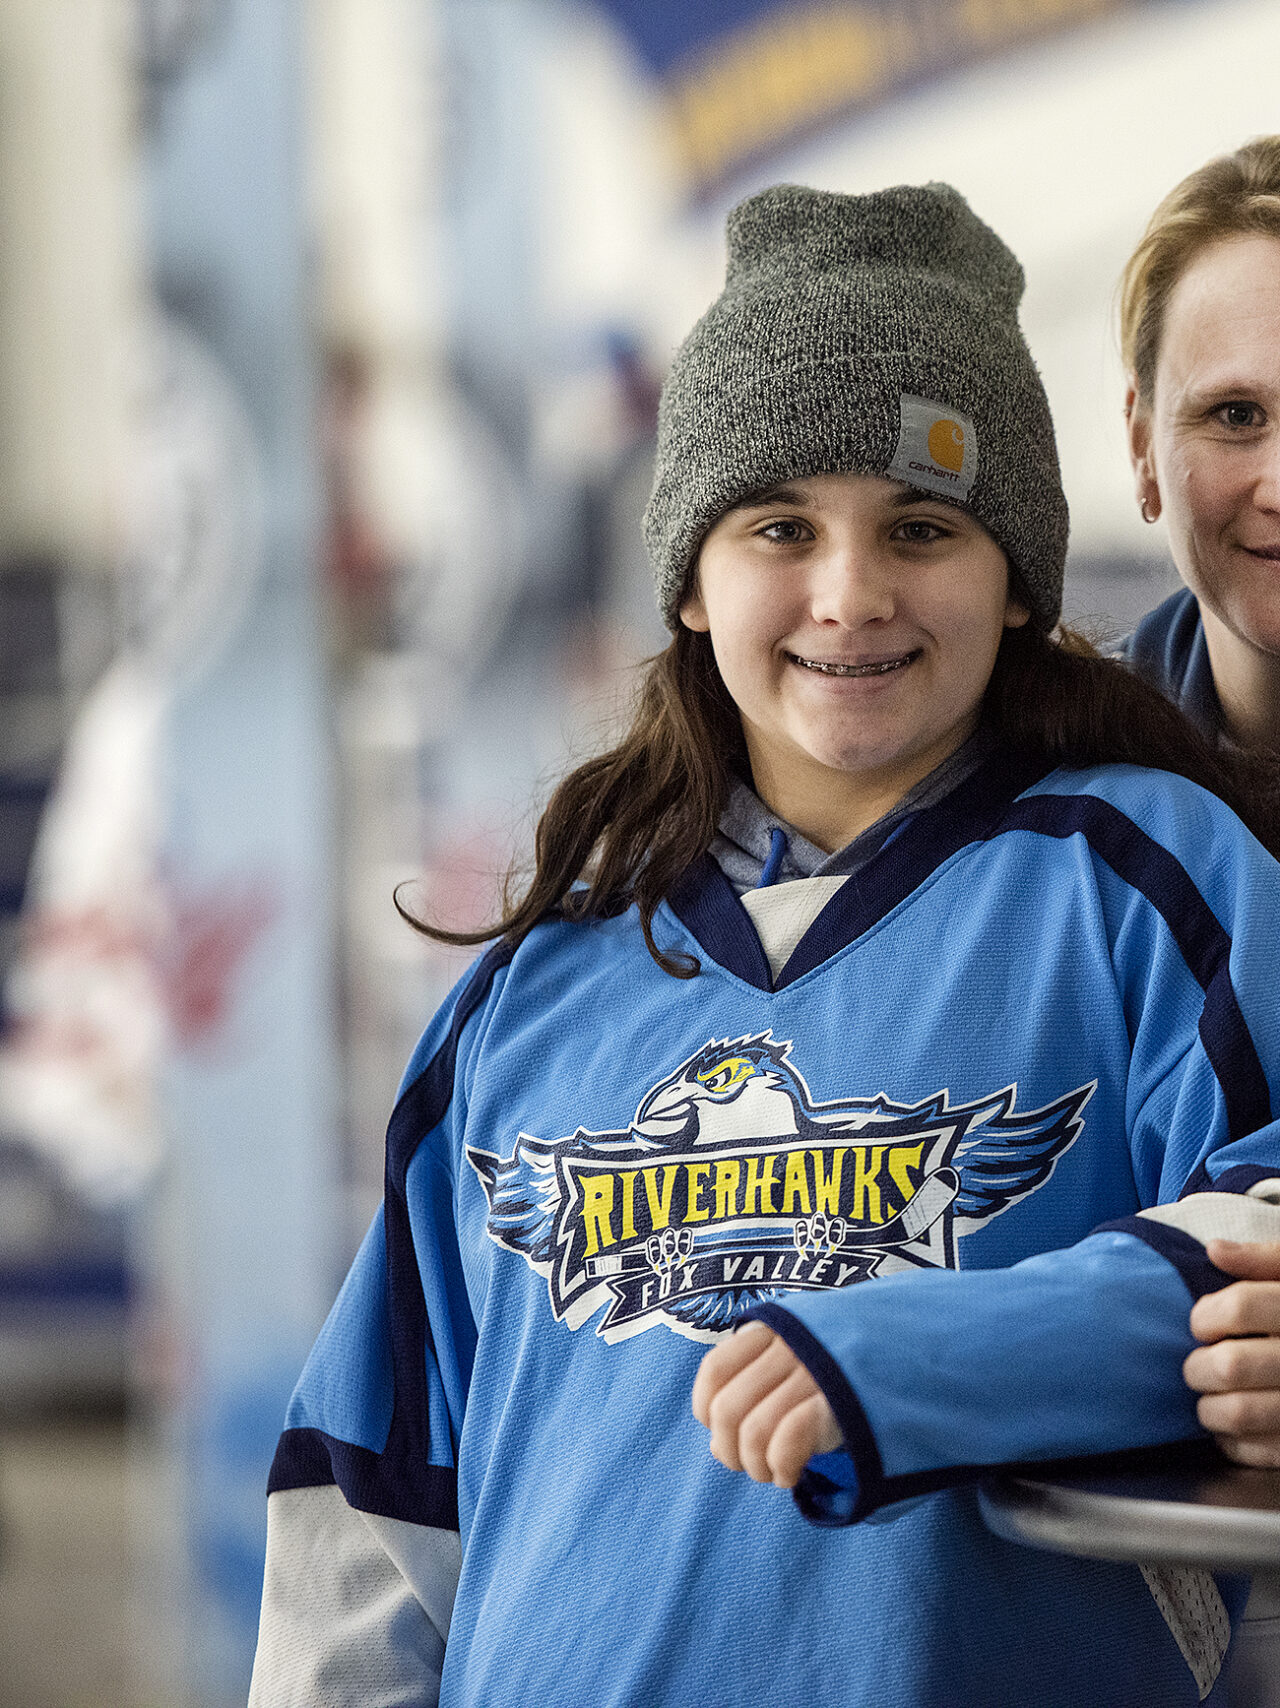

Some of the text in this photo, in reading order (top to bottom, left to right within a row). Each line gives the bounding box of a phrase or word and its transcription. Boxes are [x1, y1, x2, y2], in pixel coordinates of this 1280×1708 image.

[908, 461, 961, 481] carhartt
[577, 1141, 925, 1261] RIVERHAWKS
[641, 1255, 859, 1309] FOX VALLEY
